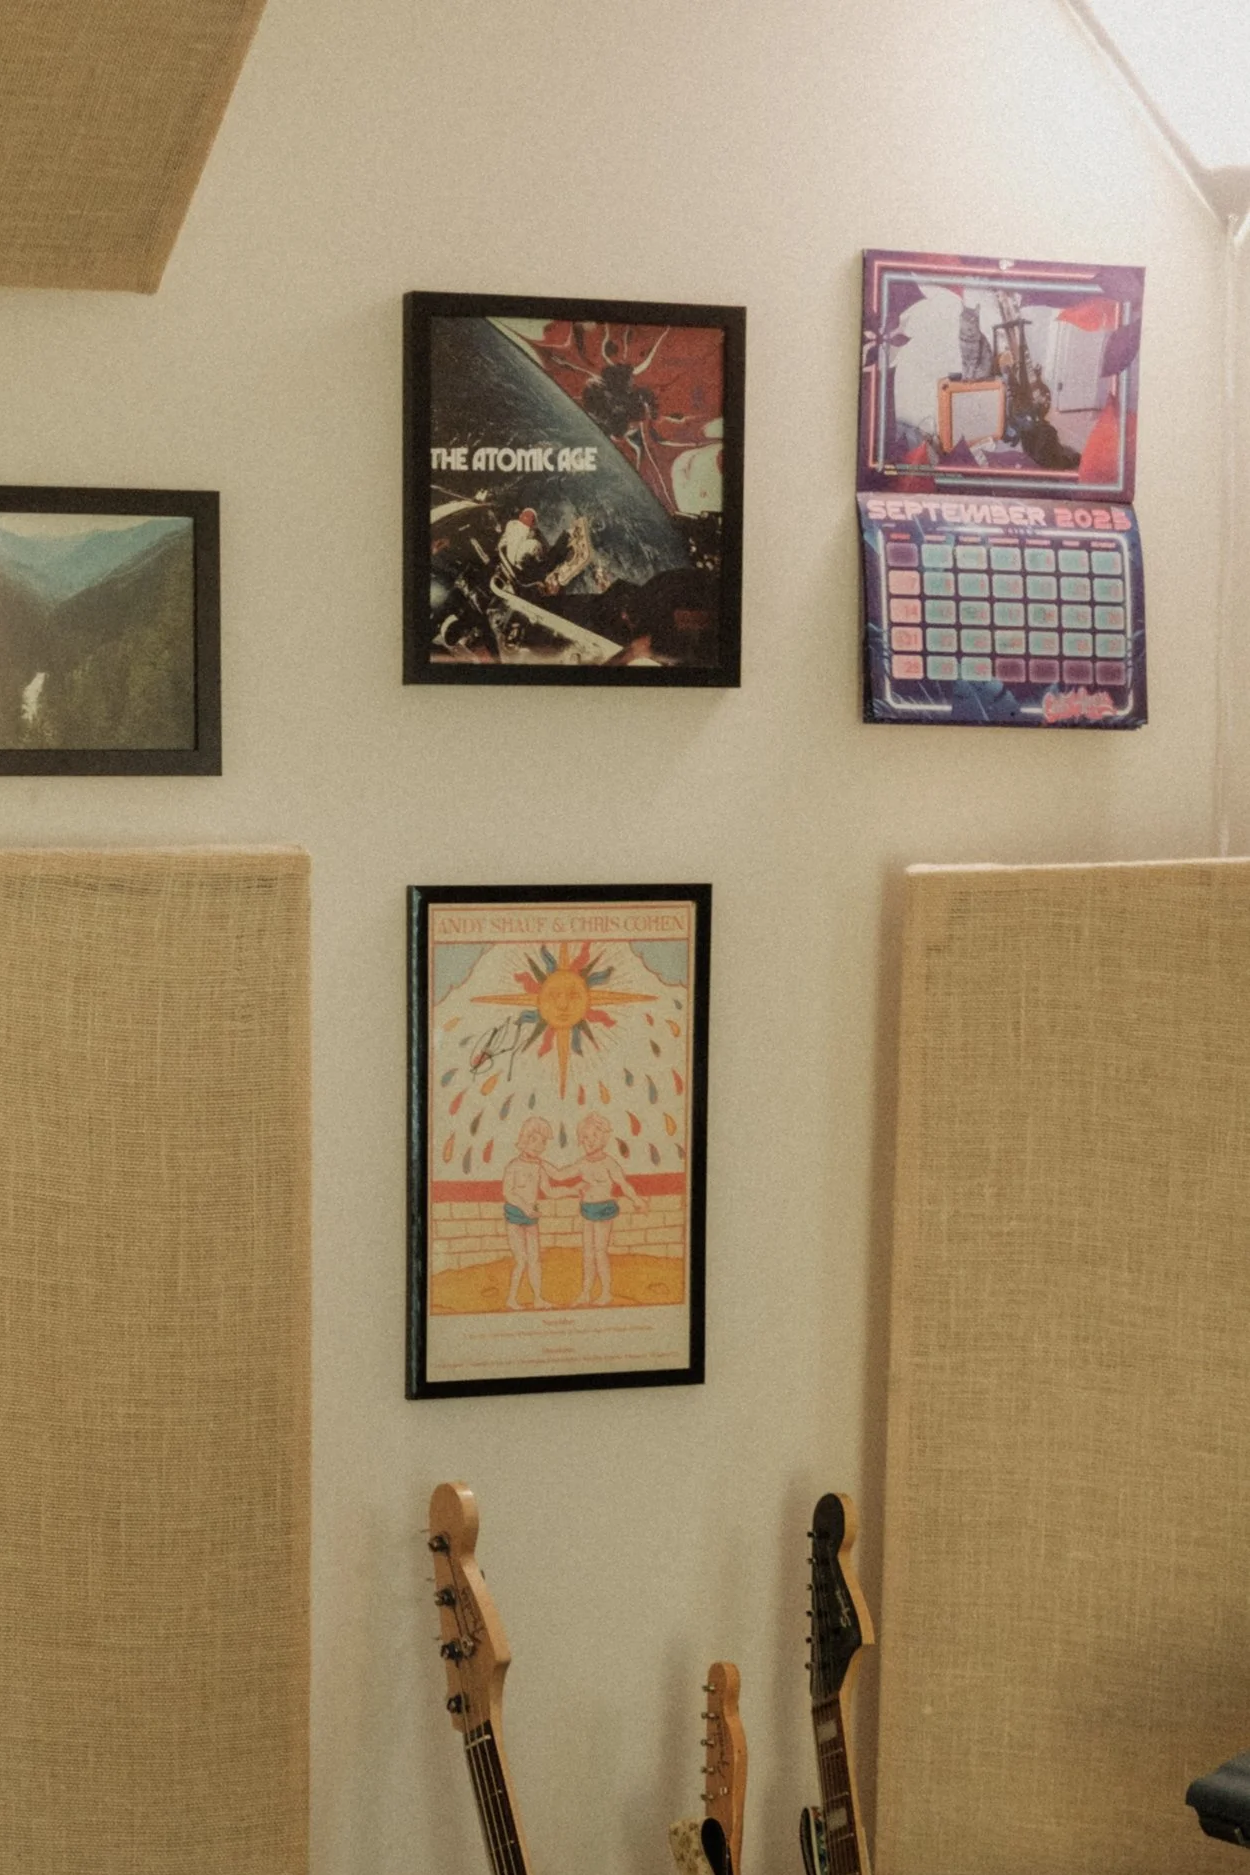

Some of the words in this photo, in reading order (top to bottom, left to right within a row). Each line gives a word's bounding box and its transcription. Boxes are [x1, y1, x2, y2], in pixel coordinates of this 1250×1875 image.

[430, 447, 469, 471] THE
[472, 447, 555, 472] ATOMIC
[557, 446, 598, 472] AGE
[866, 500, 1047, 526] SEPTEMBER
[1053, 506, 1132, 531] 2025
[437, 917, 484, 934] ANDY
[553, 916, 565, 933] &
[570, 916, 620, 933] CHRIS
[623, 914, 686, 932] COHEN
